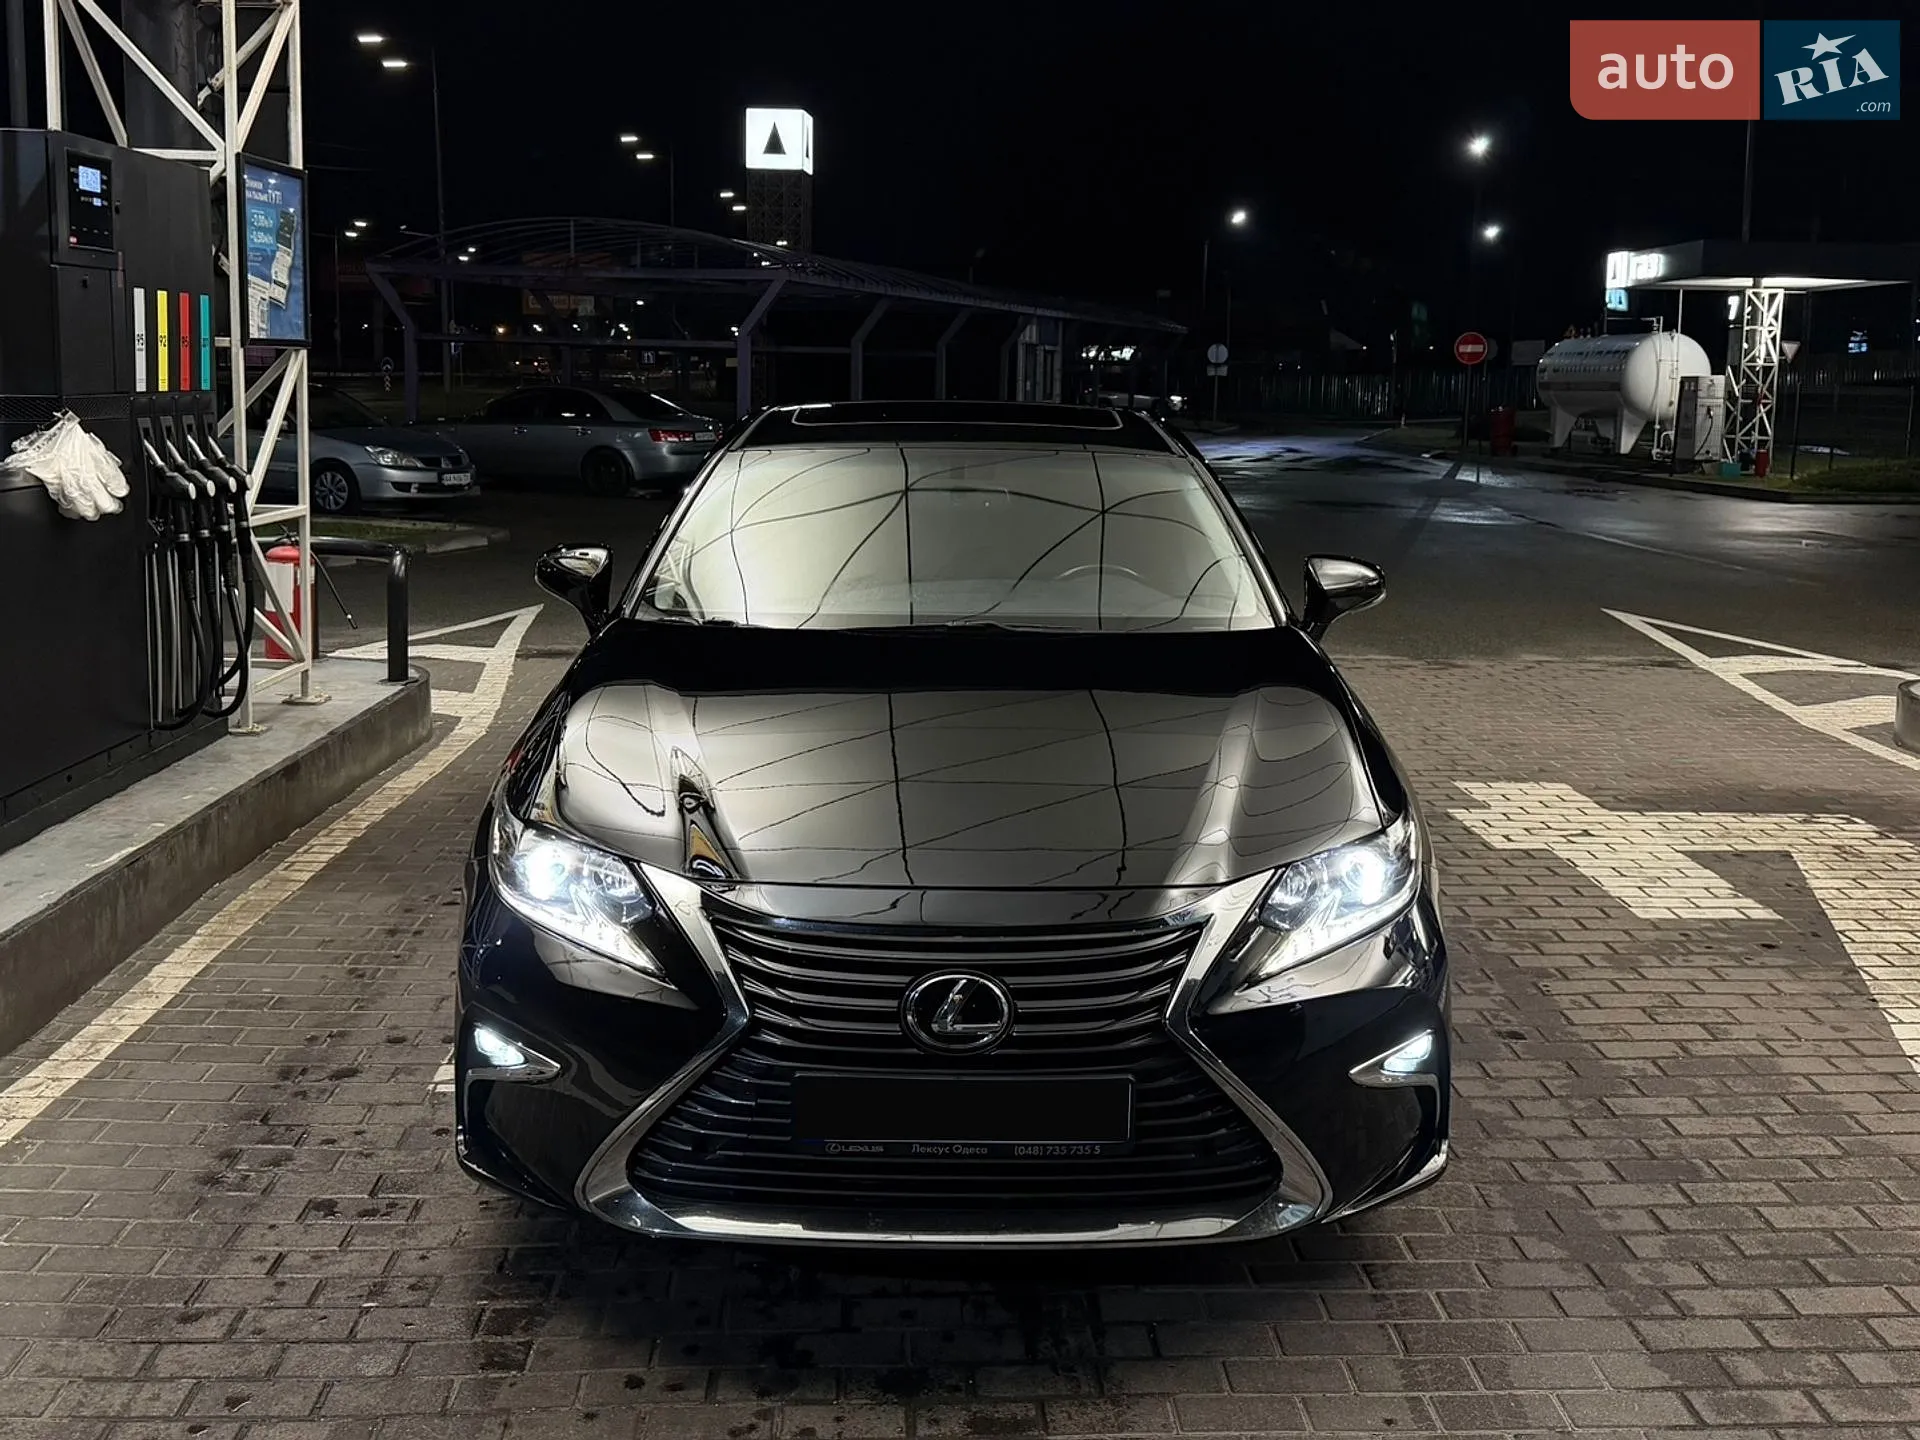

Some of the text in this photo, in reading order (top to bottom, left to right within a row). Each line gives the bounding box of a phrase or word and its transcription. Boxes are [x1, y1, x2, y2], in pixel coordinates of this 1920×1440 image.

[159, 334, 167, 348] 92
[911, 1143, 950, 1156] Лексус
[1014, 1144, 1044, 1157] (048)
[1046, 1145, 1067, 1156] 735
